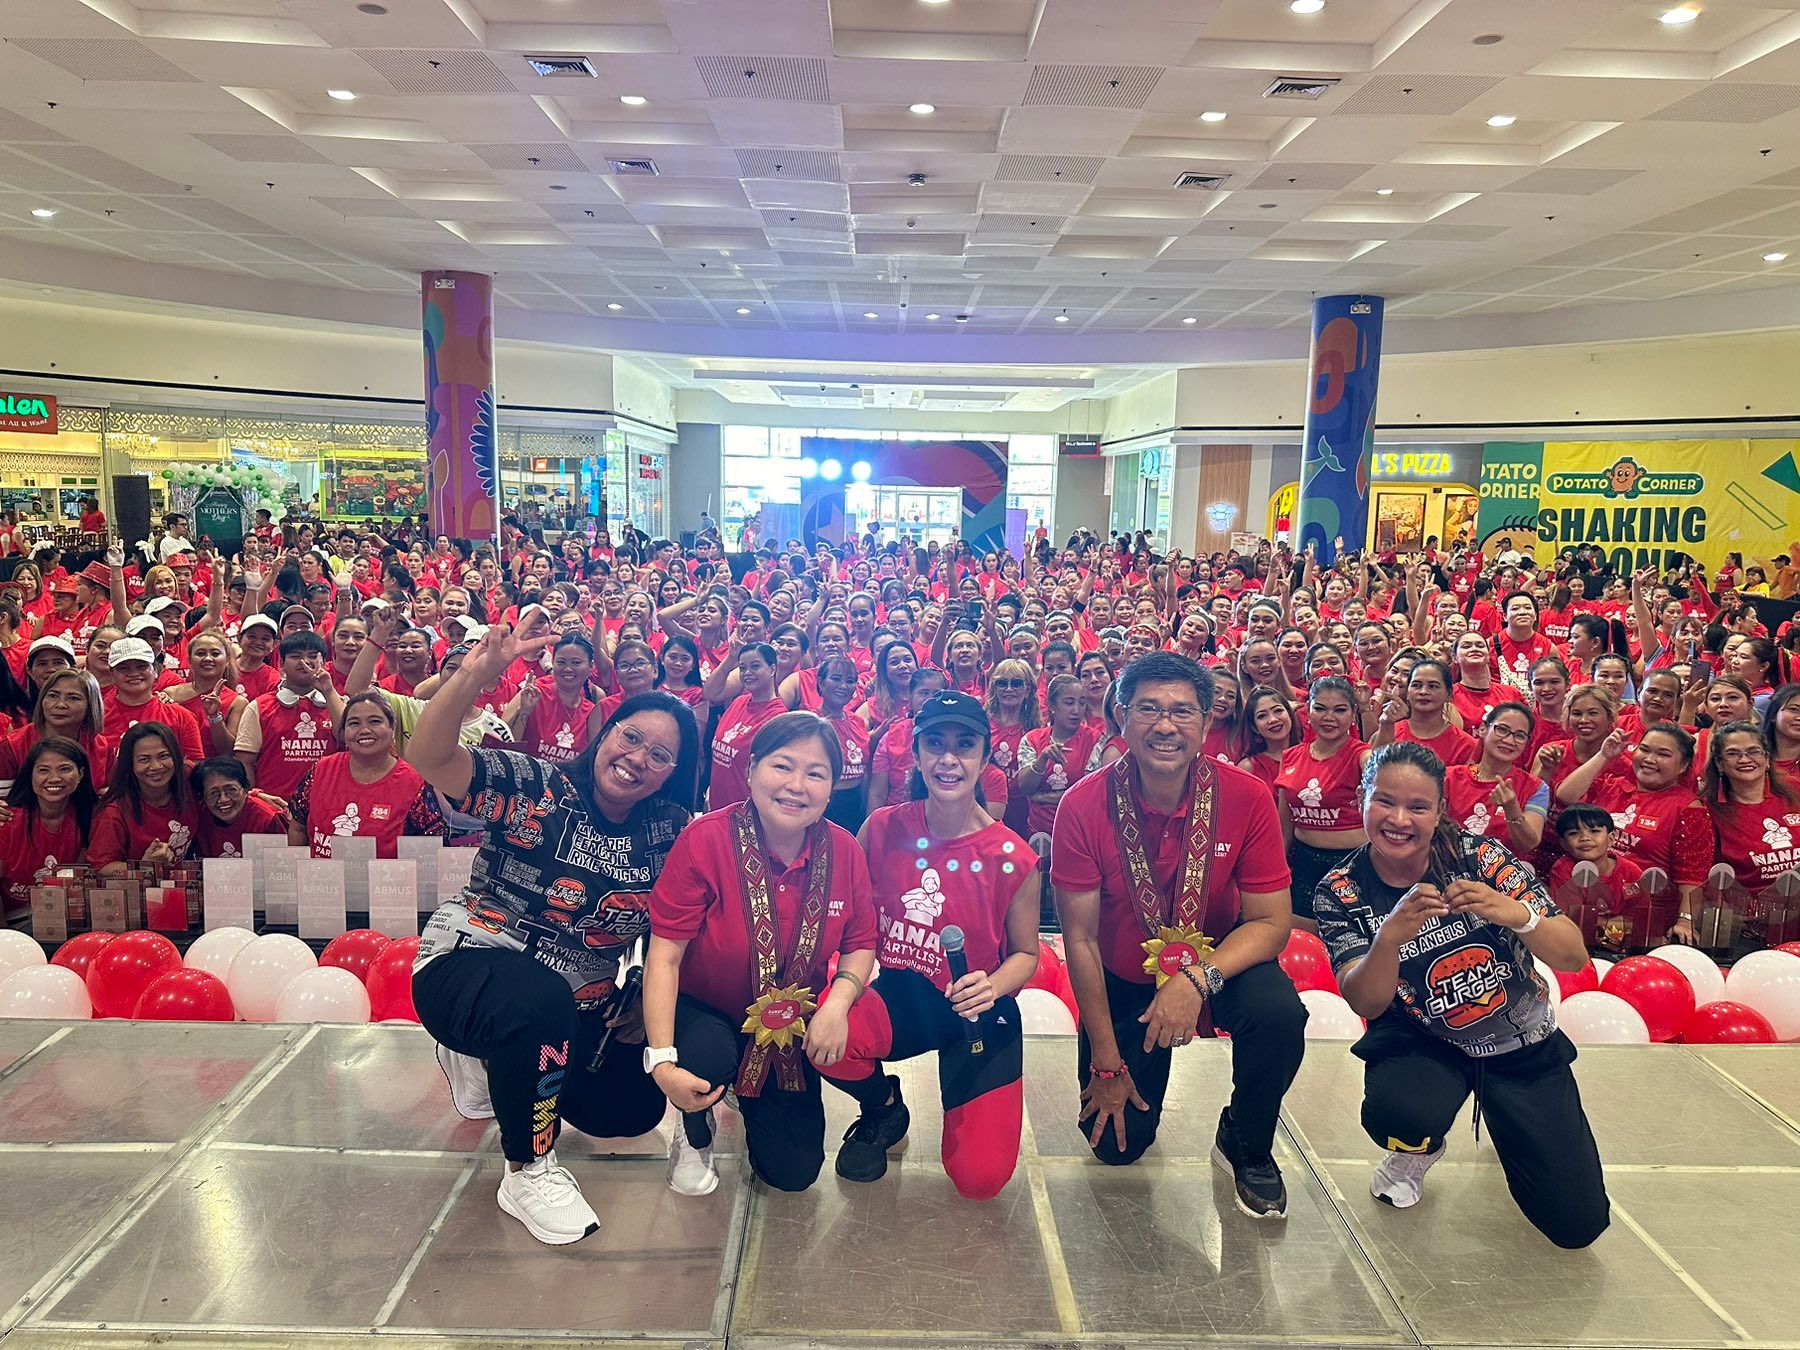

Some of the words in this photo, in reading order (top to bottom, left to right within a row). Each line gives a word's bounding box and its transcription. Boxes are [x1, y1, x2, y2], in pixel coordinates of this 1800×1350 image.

[1402, 453, 1451, 474] PIZZA
[1553, 476, 1609, 490] POTATO
[1638, 476, 1696, 492] CORNER
[1537, 506, 1706, 543] SHAKING
[371, 806, 388, 816] 284
[1640, 818, 1656, 827] 134
[556, 885, 582, 896] TEAM
[1420, 920, 1466, 954] ANGELS
[1437, 959, 1494, 994] TEAM
[1430, 962, 1512, 1016] BURGER
